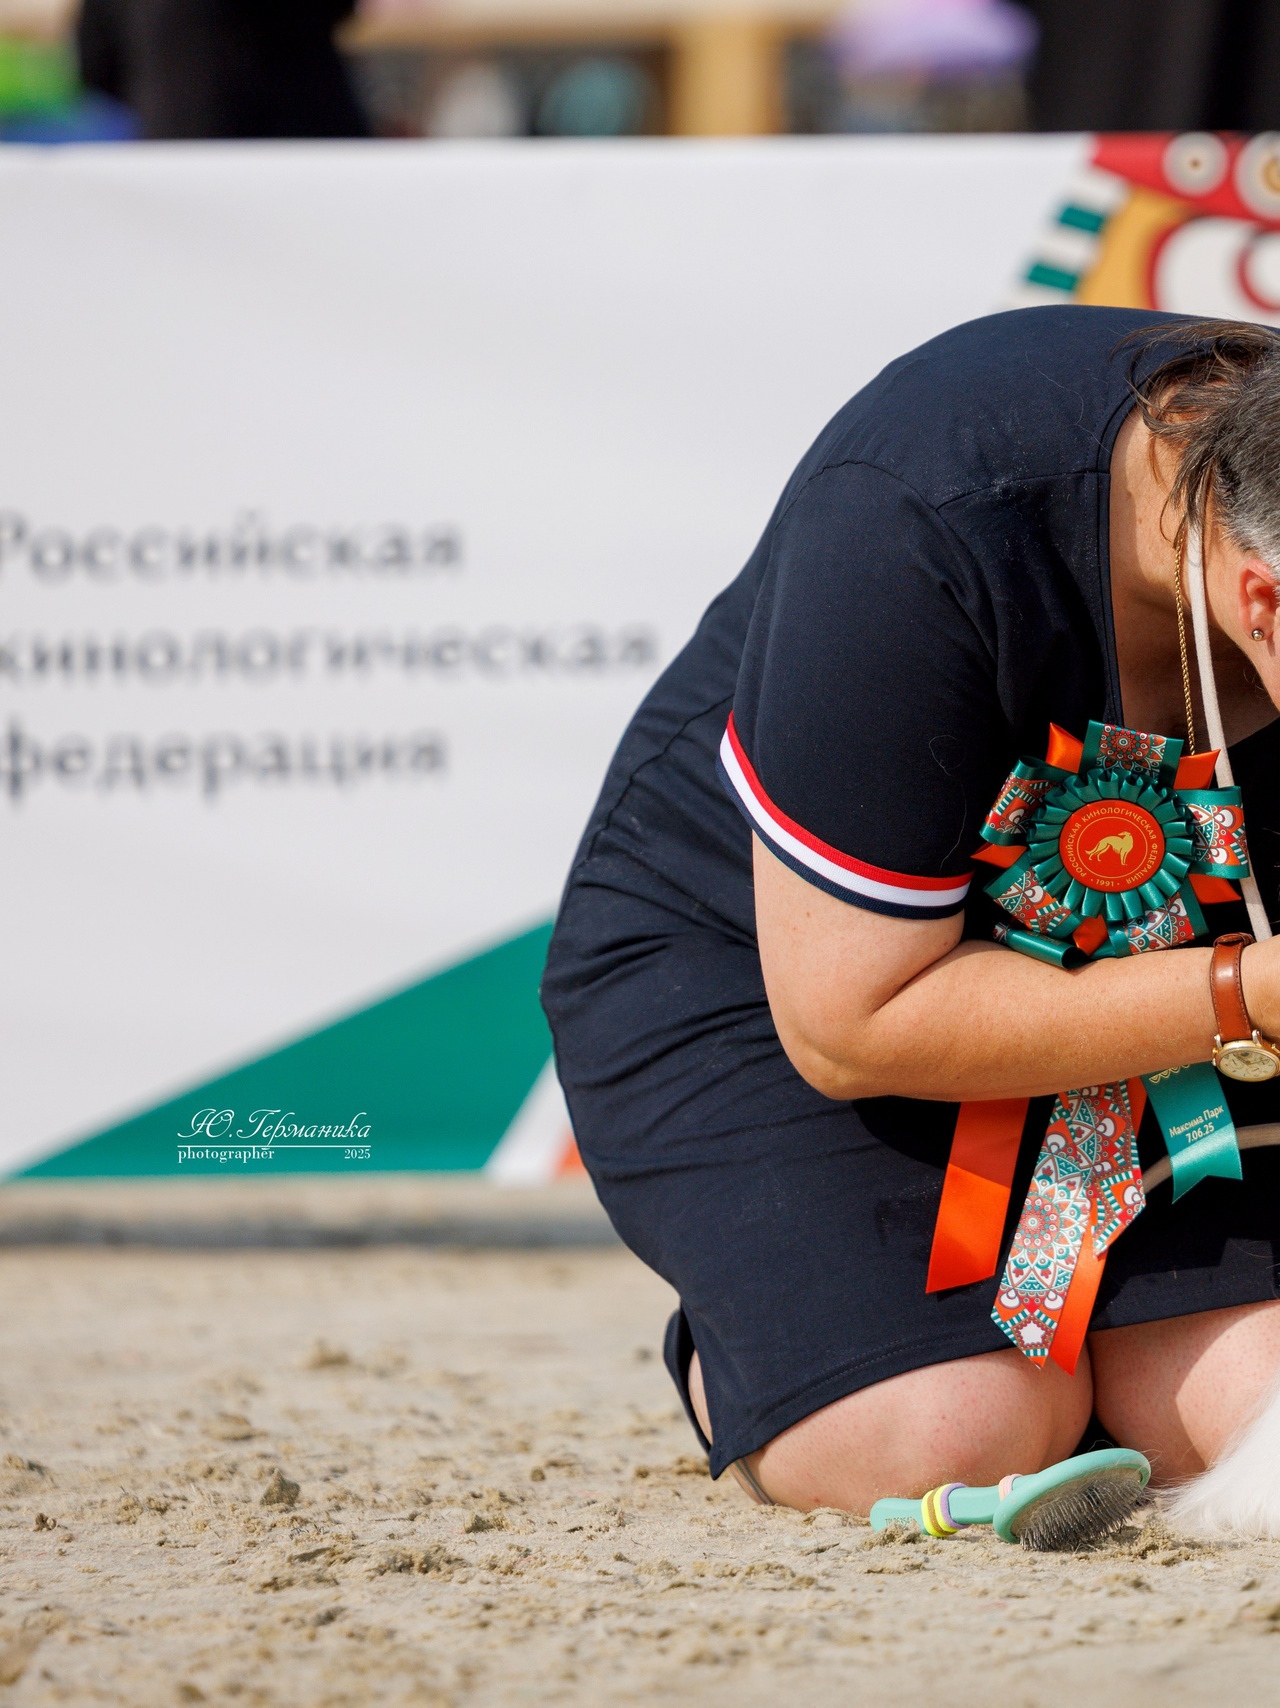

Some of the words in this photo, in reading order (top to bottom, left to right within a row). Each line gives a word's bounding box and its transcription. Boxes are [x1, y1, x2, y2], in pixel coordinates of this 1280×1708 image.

[1065, 822, 1086, 877] РОССИЙСКАЯ
[1081, 806, 1157, 840] КИНОЛОГИЧЕСКАЯ
[1126, 843, 1159, 885] ФЕДЕРАЦИЯ
[1096, 879, 1114, 887] 1991
[1169, 1115, 1204, 1138] Максима
[1202, 1105, 1224, 1121] Парк
[1185, 1121, 1215, 1143] 7.06.25
